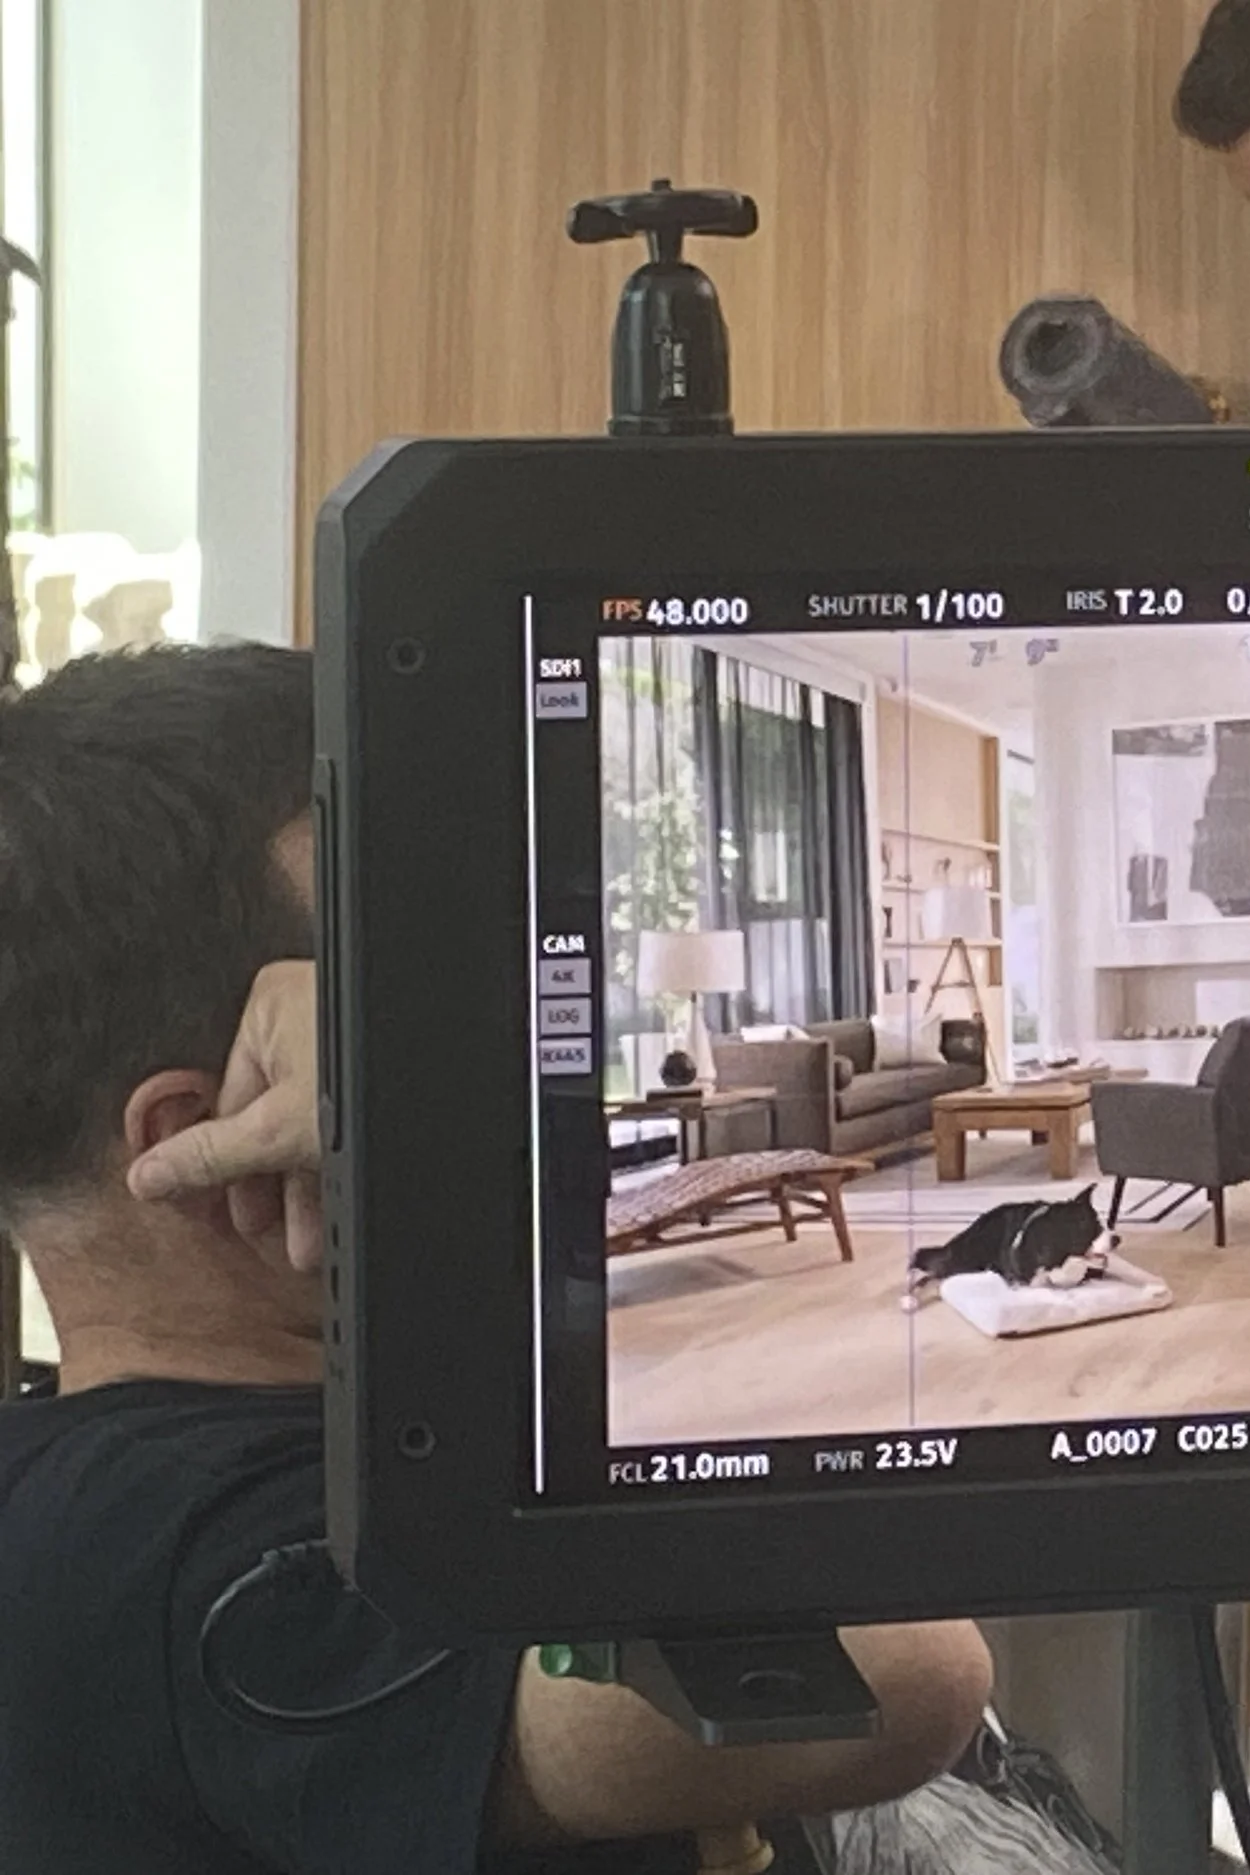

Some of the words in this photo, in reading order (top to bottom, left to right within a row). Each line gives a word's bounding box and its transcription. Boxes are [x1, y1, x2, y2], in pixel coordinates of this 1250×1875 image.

[602, 598, 644, 622] FPS
[646, 597, 749, 626] 48.000
[808, 594, 908, 618] SHUTTER
[915, 588, 1004, 624] 1/100
[1065, 589, 1107, 612] IRIS
[543, 935, 586, 954] CAM
[547, 1008, 580, 1025] LOG
[814, 1450, 865, 1474] PWR
[875, 1438, 958, 1470] 23.5V
[1050, 1427, 1157, 1463] A_0007
[1177, 1422, 1249, 1452] C025
[608, 1461, 648, 1485] FCL
[650, 1451, 771, 1482] 21.0mm
